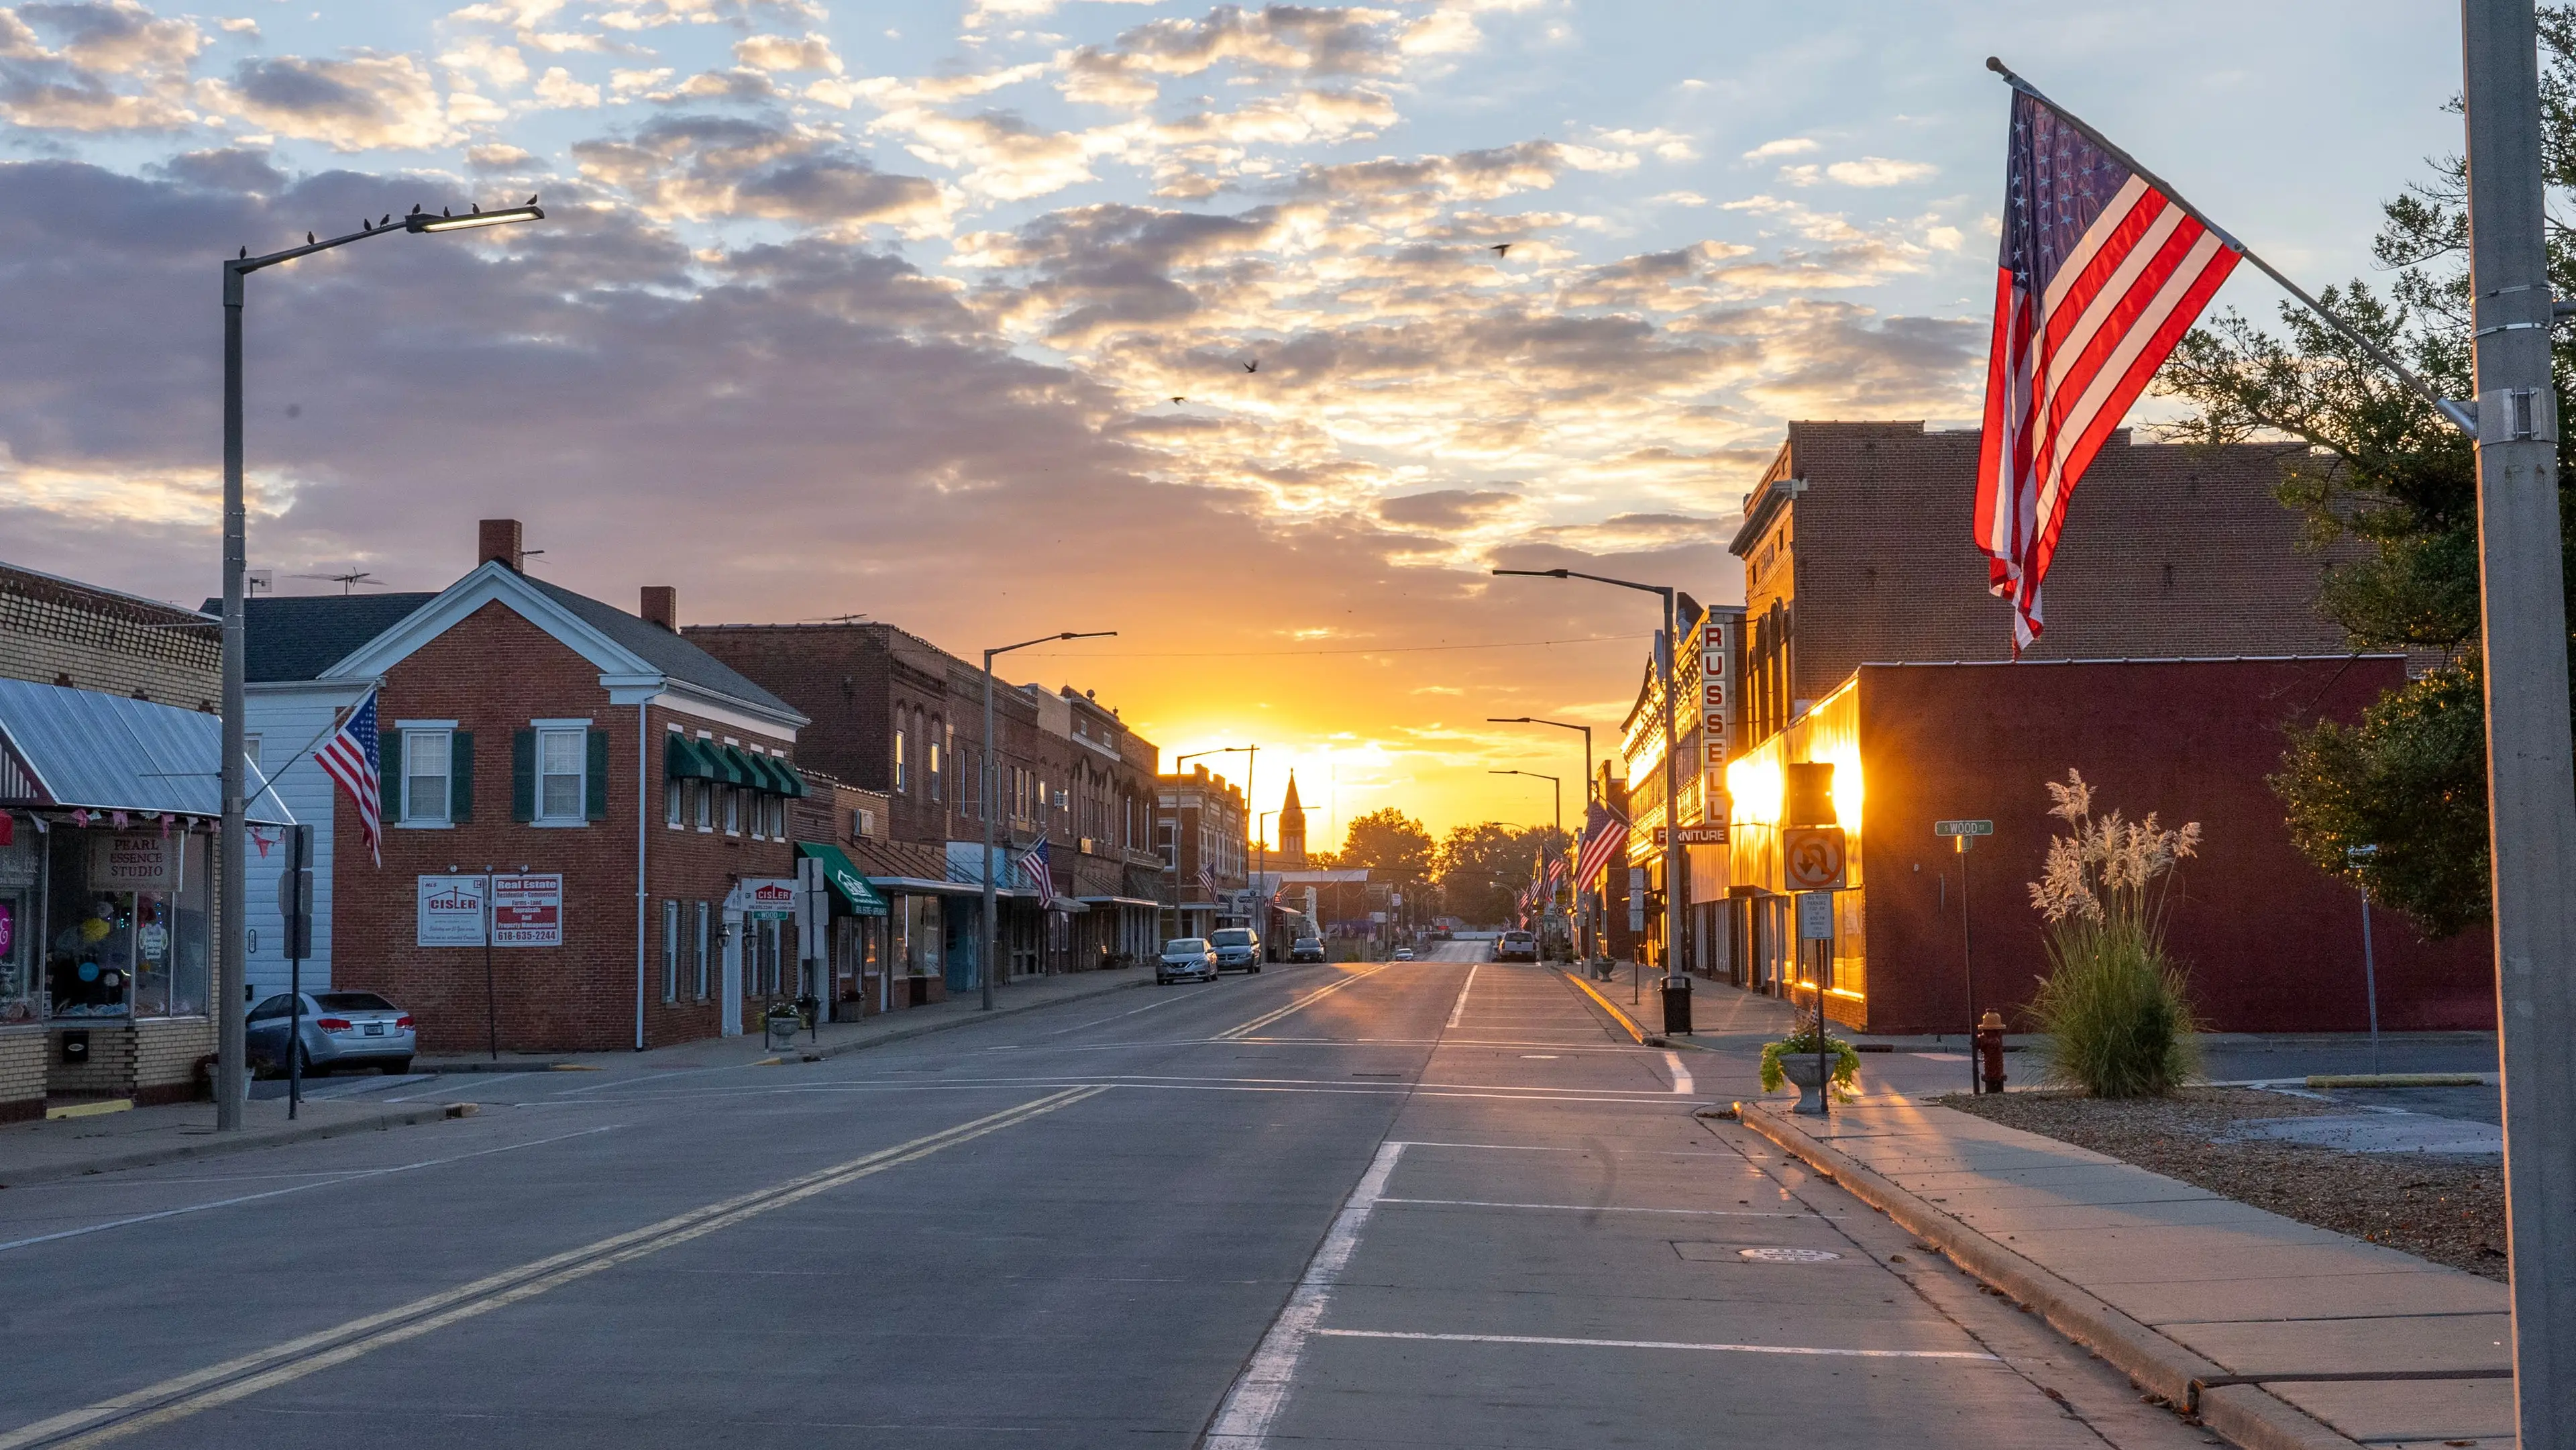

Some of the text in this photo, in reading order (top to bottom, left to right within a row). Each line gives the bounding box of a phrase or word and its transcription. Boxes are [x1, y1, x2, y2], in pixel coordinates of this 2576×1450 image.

[1705, 627, 1723, 821] RUSSELL
[1949, 823, 1978, 833] WOOD
[1658, 829, 1725, 841] FRNITURE
[114, 839, 159, 850] PEARL
[111, 853, 163, 864] ESSENCE
[111, 866, 163, 877] STUDIO
[497, 880, 557, 889] Real Estate
[758, 886, 789, 899] CISLER
[498, 931, 556, 941] 618-635-2244
